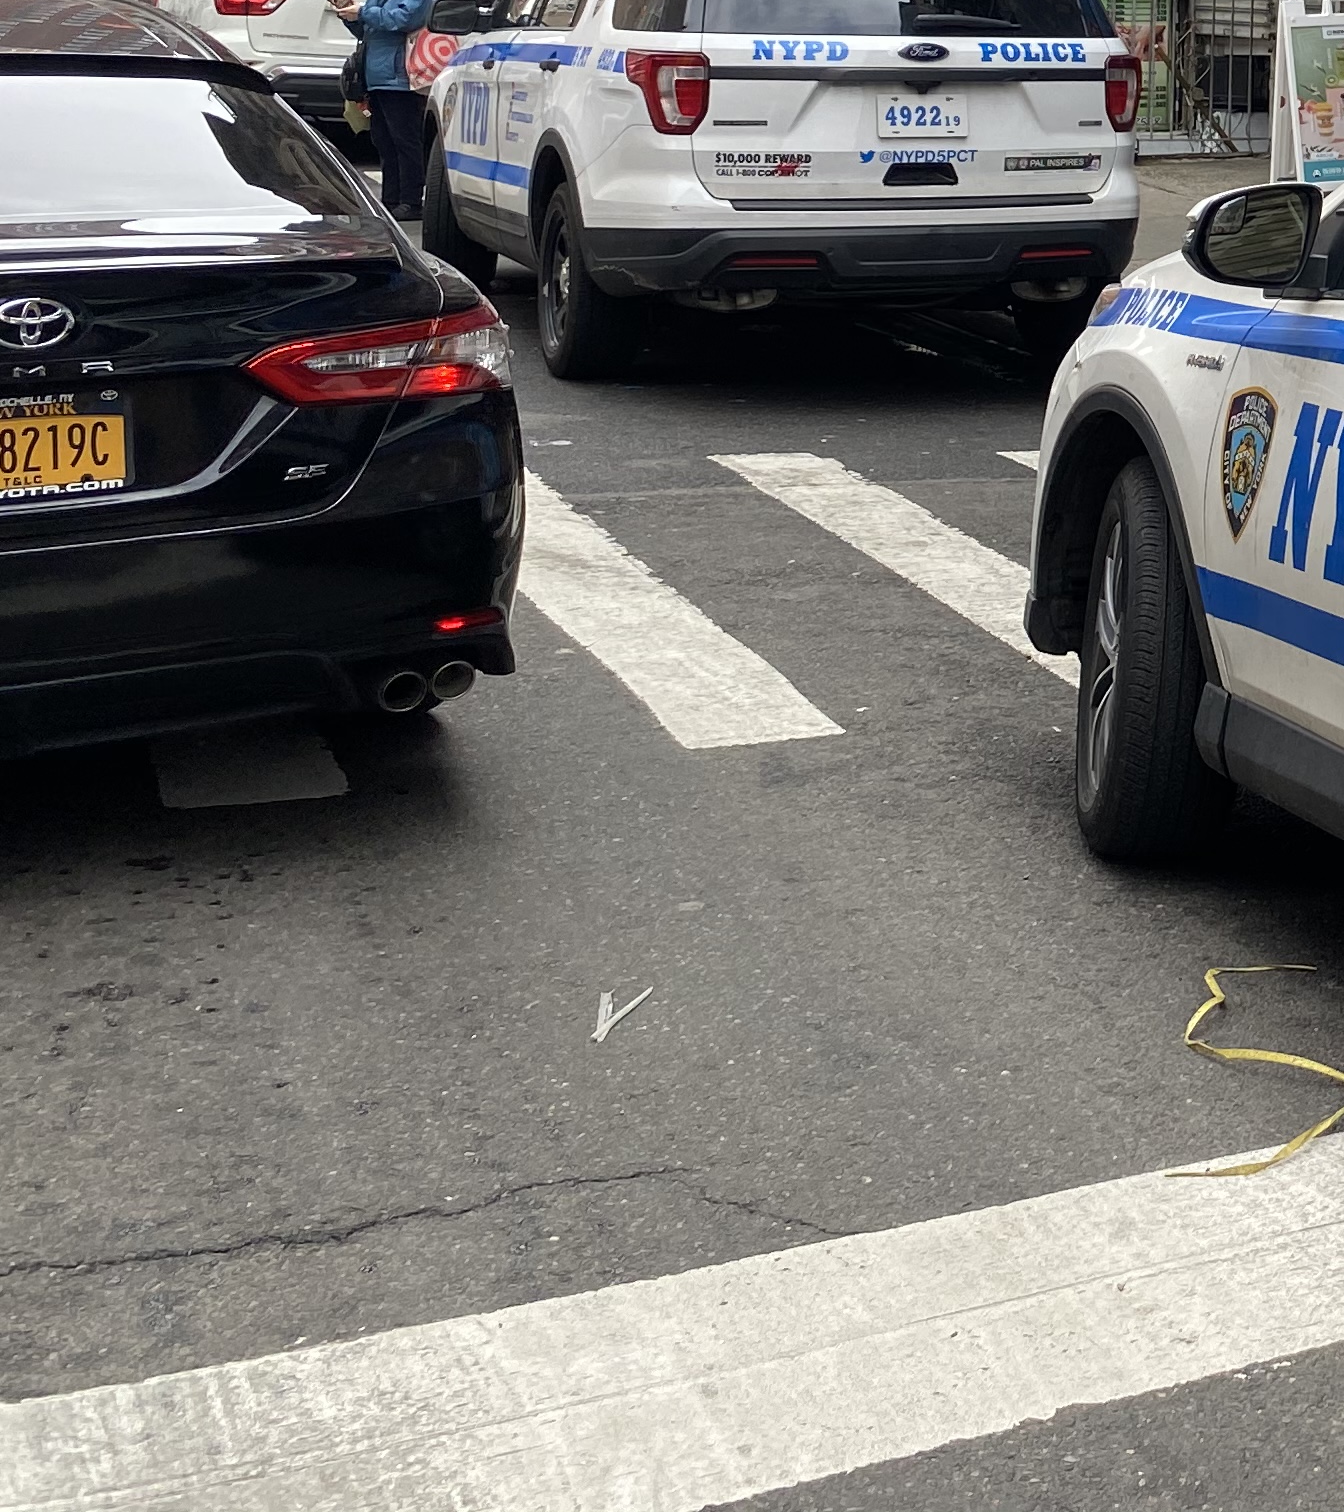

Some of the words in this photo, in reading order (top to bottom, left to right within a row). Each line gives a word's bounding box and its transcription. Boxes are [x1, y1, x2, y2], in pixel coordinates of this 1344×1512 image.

[752, 40, 850, 62] NYPD
[908, 44, 939, 59] Ford
[978, 43, 1087, 63] POLICE
[885, 105, 942, 127] 4922
[944, 114, 961, 127] 19
[715, 152, 762, 166] $10,000
[764, 152, 812, 165] REWARD
[880, 149, 978, 164] @NYPD5PCT
[1029, 157, 1046, 168] PAL
[1047, 156, 1085, 168] INSPIRES
[716, 168, 734, 177] CALL
[1117, 288, 1190, 332] POLICE
[23, 402, 77, 417] YORK
[1243, 394, 1269, 418] POLICE
[1229, 410, 1272, 443] DEPARTMENT
[0, 421, 109, 474] 8219C
[284, 463, 329, 481] SE
[1223, 450, 1231, 485] CITY
[3, 475, 42, 487] T&LC
[1239, 493, 1253, 524] NEW
[1252, 453, 1267, 490] YORK
[1225, 491, 1233, 510] OF
